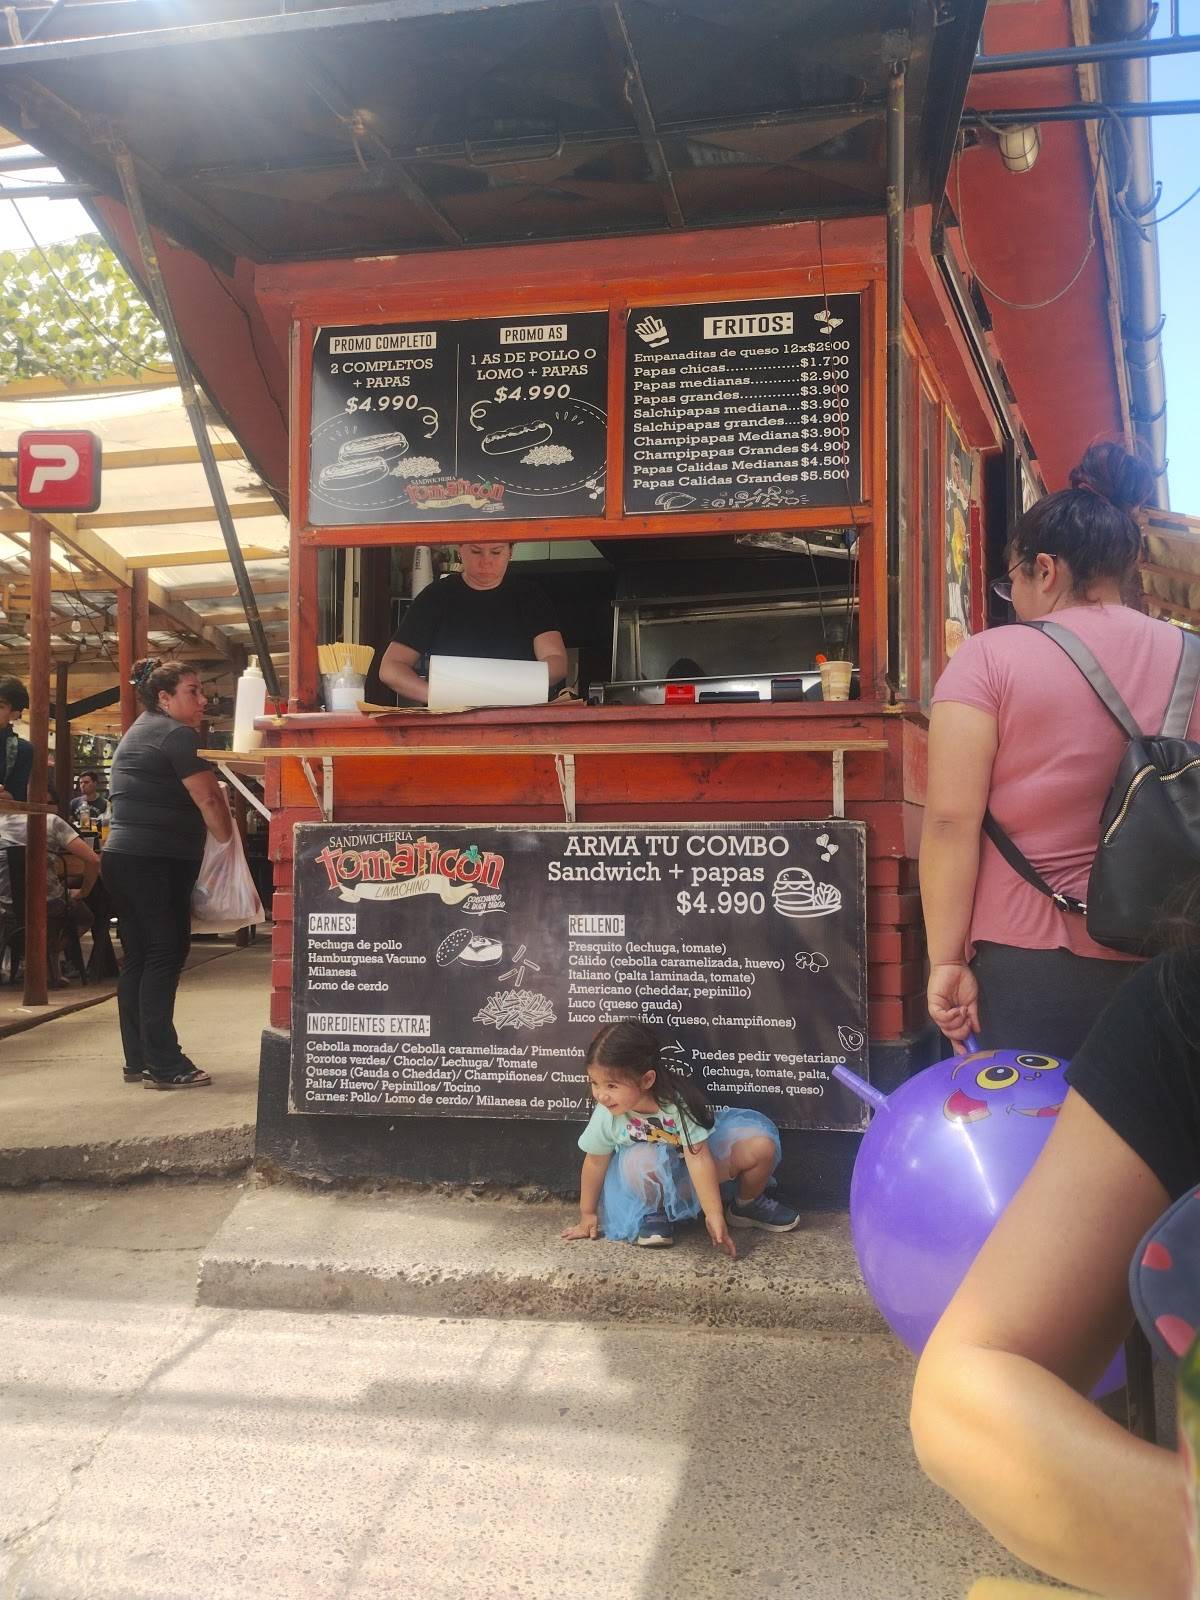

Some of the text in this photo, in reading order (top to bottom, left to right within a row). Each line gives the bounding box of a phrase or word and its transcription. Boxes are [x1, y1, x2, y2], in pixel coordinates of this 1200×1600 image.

[712, 316, 792, 336] FRITOS:
[334, 334, 432, 351] PROMO COMPLETO
[505, 327, 563, 342] PROMO AS
[471, 349, 597, 365] 1 AS DE POLLO O
[634, 351, 717, 363] Empanaditas
[720, 349, 737, 358] de
[740, 347, 779, 358] queso
[330, 358, 433, 374] 2 COMPLETOS
[477, 365, 588, 380] LOMO + PAPAS
[634, 367, 676, 378] Papas
[353, 376, 410, 388] + PAPAS
[634, 381, 676, 392] Papas
[494, 385, 570, 403] $4.990
[634, 395, 676, 406] Papas
[345, 395, 418, 414] $4.990
[634, 407, 720, 419] Salchipapas
[634, 421, 720, 433] Salchipapas
[633, 427, 850, 447] Champipapas Mediana $3.900
[633, 441, 850, 461] Champipapas Grandes $4.900
[633, 455, 850, 476] Papas Calidas Medianas $4.500
[633, 470, 850, 490] Papas Calidas Grandes $5.500
[329, 831, 413, 848] SANDWICHERIA
[564, 835, 790, 858] ARMA TU COMBO
[548, 862, 765, 887] Sandwich + papas
[375, 878, 430, 898] LIMACHINO
[676, 891, 766, 915] $4.990
[309, 916, 356, 932] CARNES:
[569, 917, 625, 935] RELLENO:
[308, 939, 403, 952] Pechuga de pollo
[568, 941, 727, 956] Fresquito (lechuga, tomate)
[308, 952, 427, 966] Hamburguesa Vacuno
[568, 955, 785, 972] Cálido (cebolla caramelizada, huevo)
[308, 966, 357, 977] Milanesa
[568, 969, 756, 985] Italiano (palta laminada, tomate)
[308, 980, 389, 991] Lomo de cerdo
[568, 983, 752, 1000] Americano (cheddar, pepinillo)
[568, 997, 682, 1012] Luco (queso gauda)
[308, 1016, 430, 1034] INGREDIENTES EXTRA:
[568, 1012, 596, 1023] Luco
[667, 1014, 710, 1027] (queso,
[711, 1014, 796, 1030] champiñones)
[306, 1041, 585, 1057] Cebolla morada/ Cebolla caramelizada/ Pimentón
[692, 1049, 847, 1065] Puedes pedir vegetariano
[306, 1053, 538, 1070] Porotos verdes/ Choclo/ Lechuga/ Tomate
[305, 1066, 347, 1077] Quesos
[350, 1067, 390, 1079] (Gauda
[392, 1070, 400, 1078] o
[402, 1068, 461, 1082] Cheddar)/
[464, 1069, 548, 1083] Champiñones/
[702, 1066, 830, 1081] (lechuga, tomate, palta,
[305, 1079, 481, 1093] Palta/ Huevo/ Pepinillos/ Tocino
[706, 1082, 824, 1097] champiñones, queso)
[305, 1091, 348, 1102] Carnes:
[350, 1092, 383, 1103] Pollo/
[384, 1093, 415, 1104] Lomo
[418, 1094, 433, 1104] de
[435, 1095, 474, 1106] cerdo/
[476, 1095, 527, 1107] Milanesa
[530, 1097, 545, 1107] de
[547, 1098, 583, 1110] pollo/
